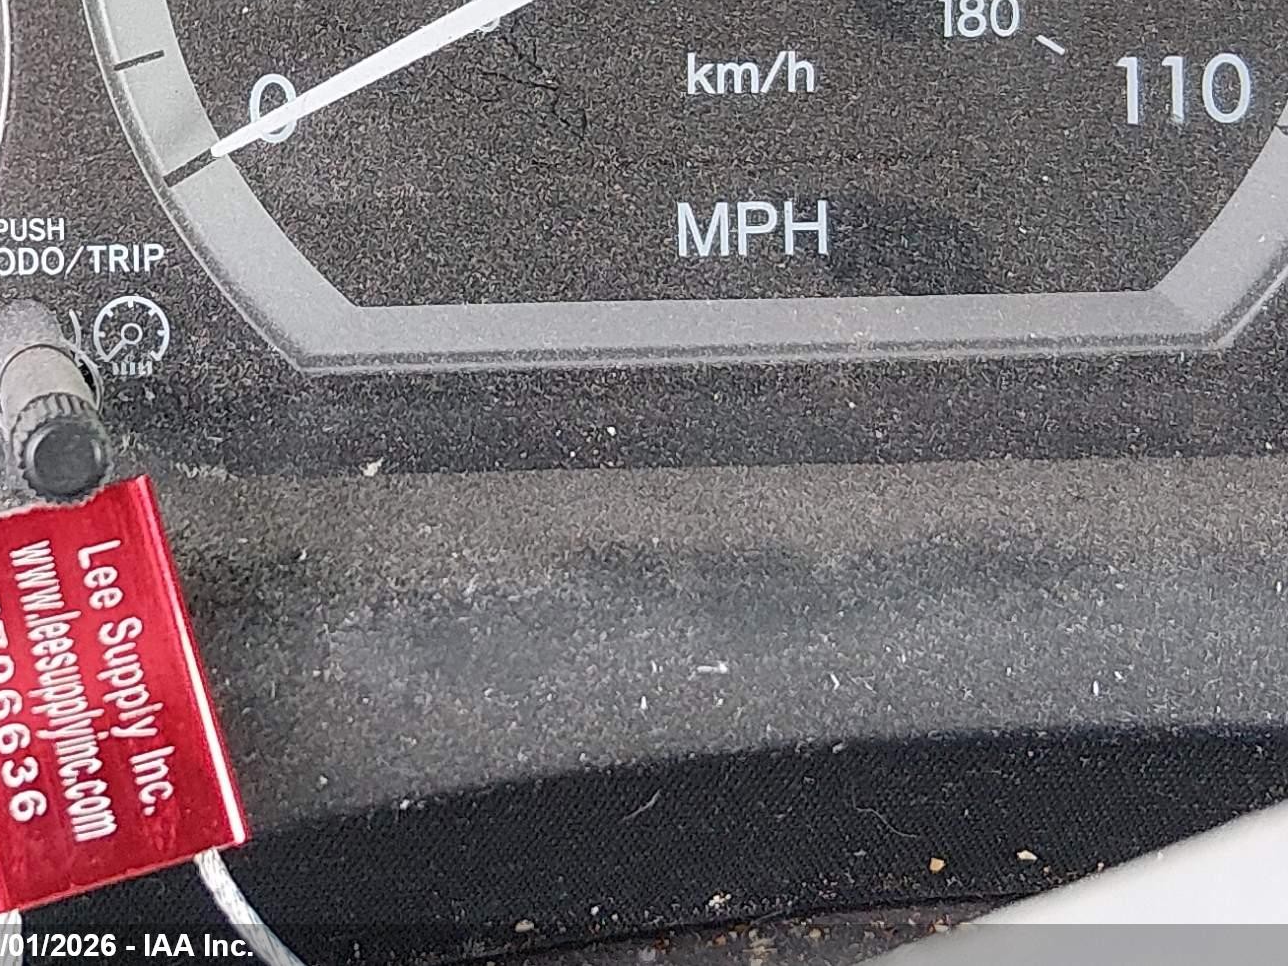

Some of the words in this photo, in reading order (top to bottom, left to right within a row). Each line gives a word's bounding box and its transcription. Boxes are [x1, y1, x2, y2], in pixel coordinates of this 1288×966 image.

[685, 50, 815, 94] km/h
[1116, 52, 1251, 126] 110
[249, 74, 298, 143] 0
[676, 199, 831, 257] MPH
[78, 539, 124, 610] Lee
[9, 540, 118, 842] www.leesupplyinc.com
[96, 616, 165, 739] Supply
[128, 745, 176, 816] Inc.
